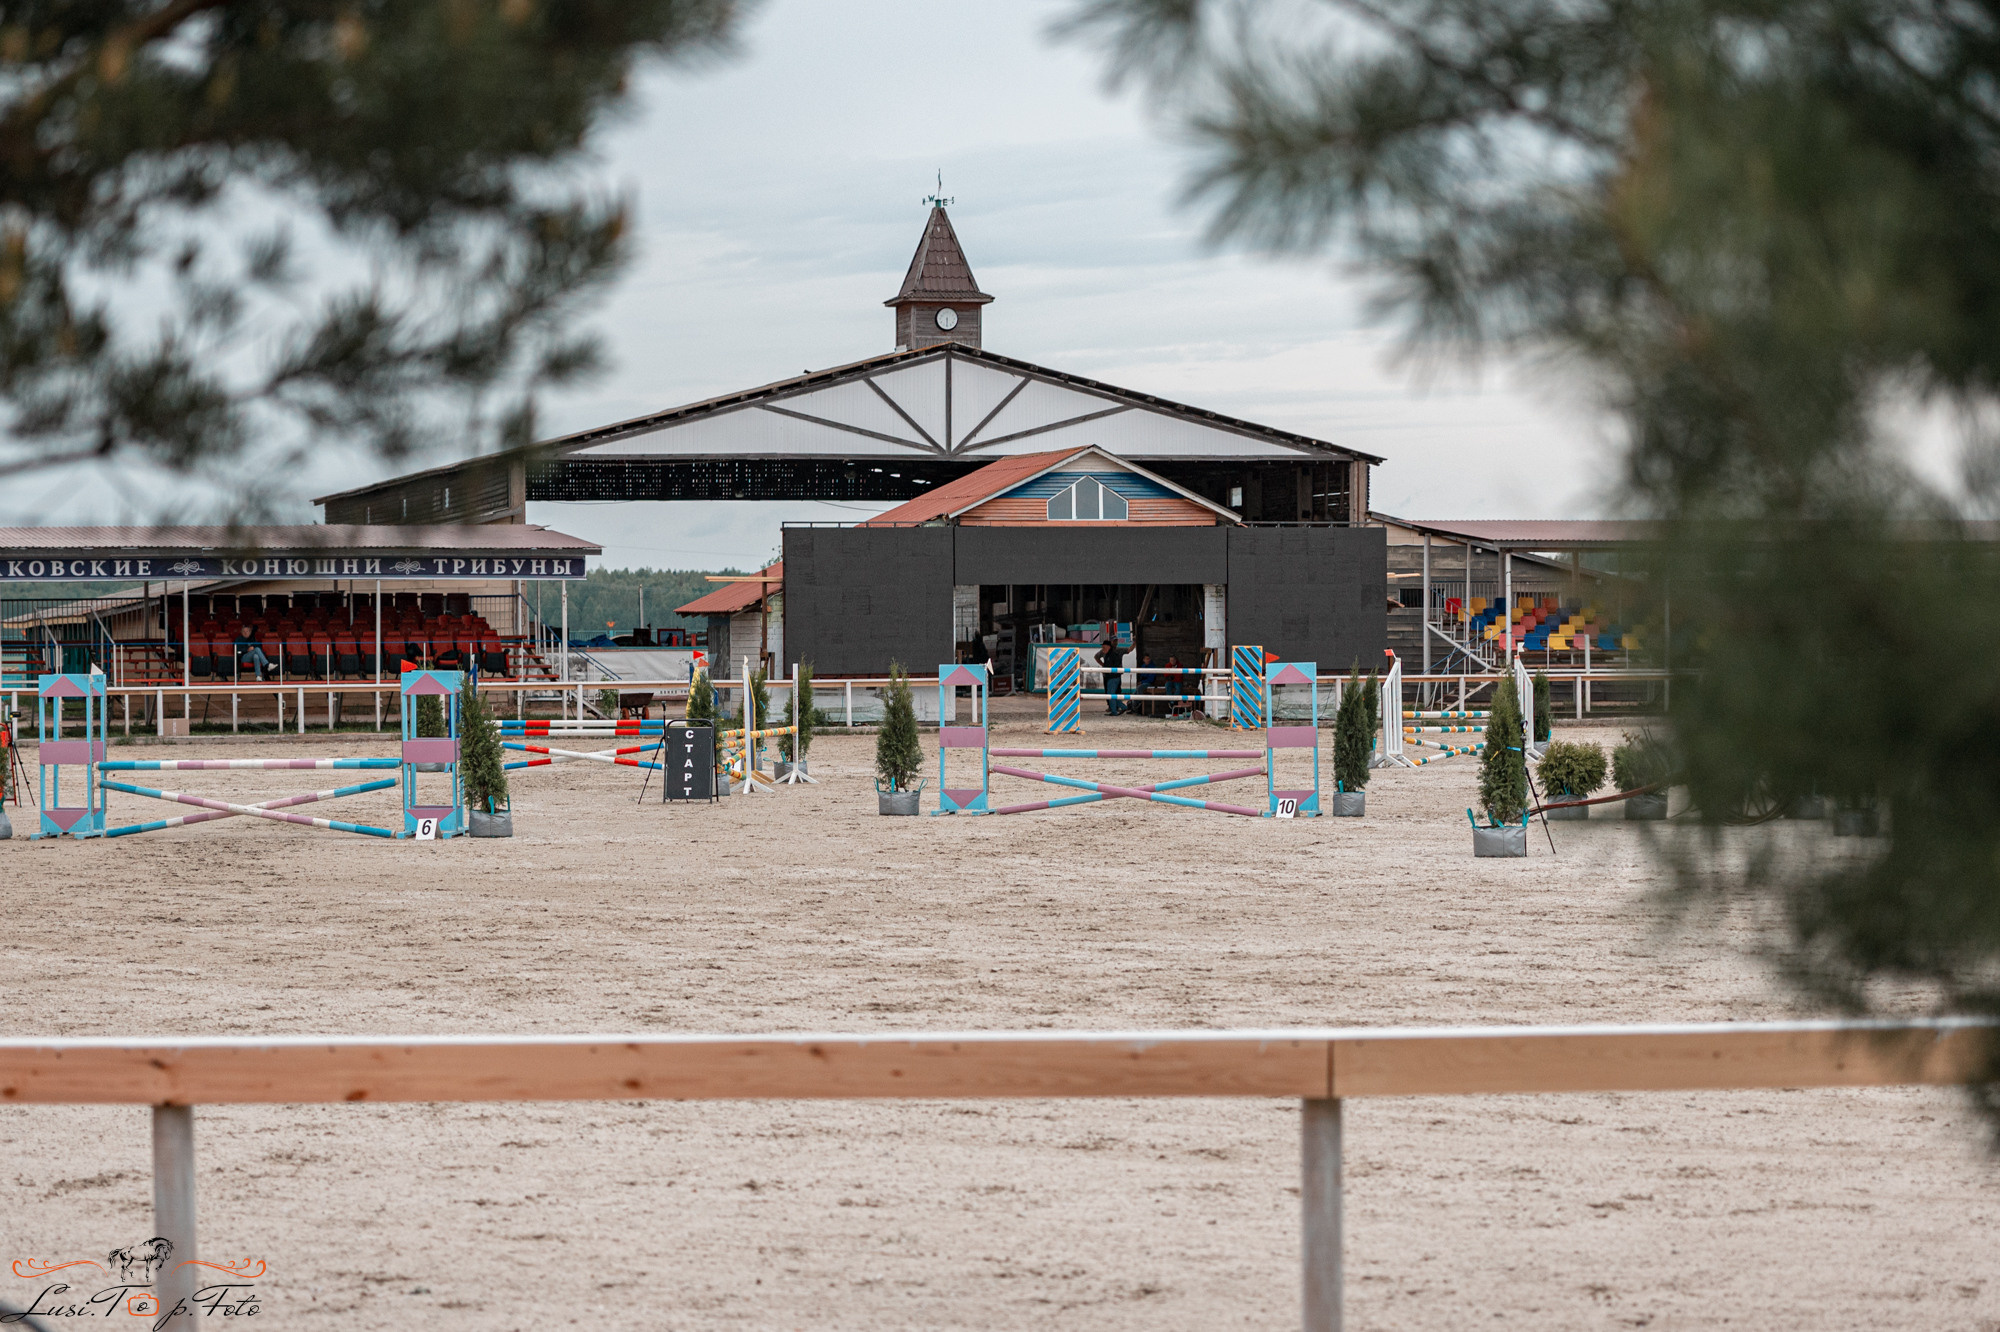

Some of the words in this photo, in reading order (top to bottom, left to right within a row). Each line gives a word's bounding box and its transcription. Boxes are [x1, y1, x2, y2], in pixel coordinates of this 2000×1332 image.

[0, 559, 152, 577] КОВСКИЕ
[220, 558, 382, 576] КОНЮШНИ
[433, 557, 572, 576] ТРИБУНЫ
[683, 729, 694, 796] СТАРТ
[1279, 799, 1295, 814] 10
[421, 819, 432, 836] 6
